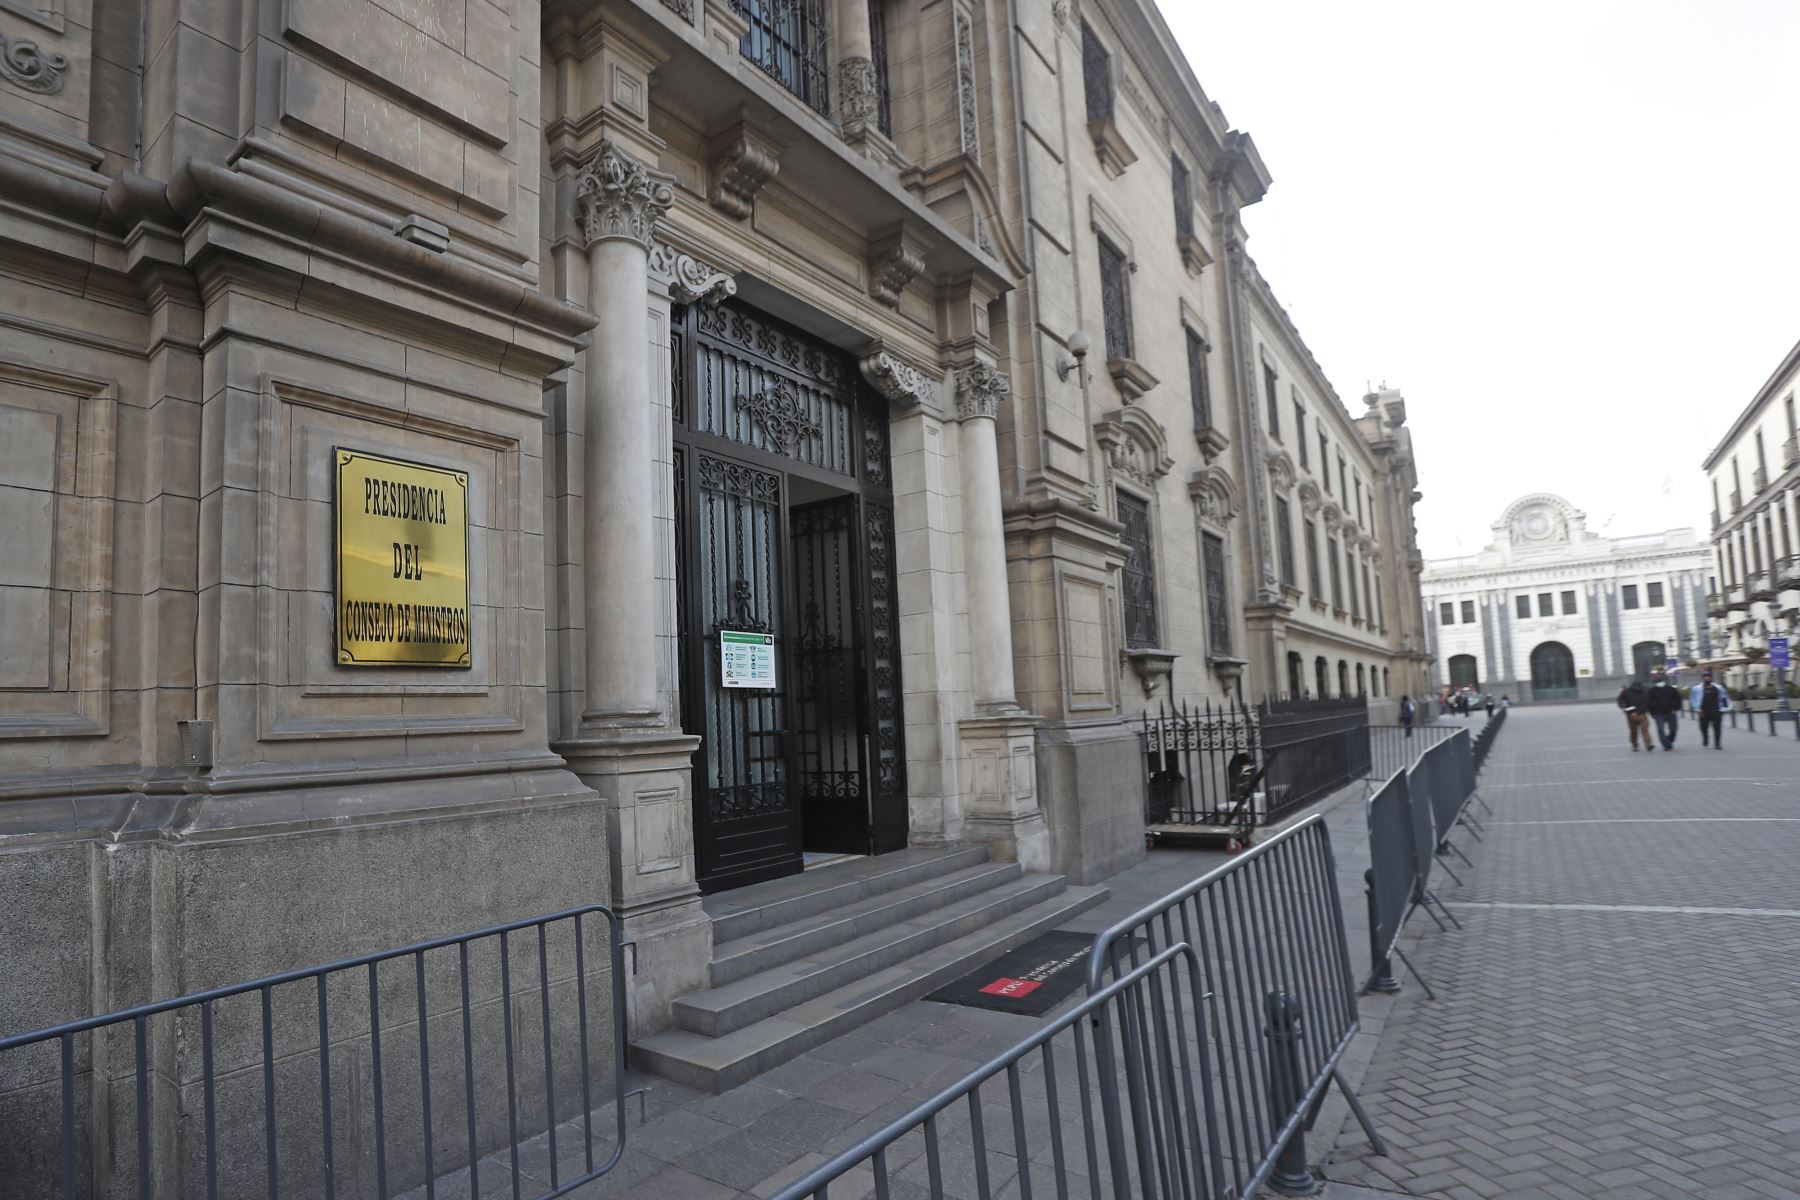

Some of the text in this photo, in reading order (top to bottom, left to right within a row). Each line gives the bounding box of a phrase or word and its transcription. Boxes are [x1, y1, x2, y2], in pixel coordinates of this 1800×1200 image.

[364, 477, 447, 525] PRESIDENCIA
[392, 542, 423, 581] DEL
[346, 600, 465, 645] CONSEJO DE MINISTROS
